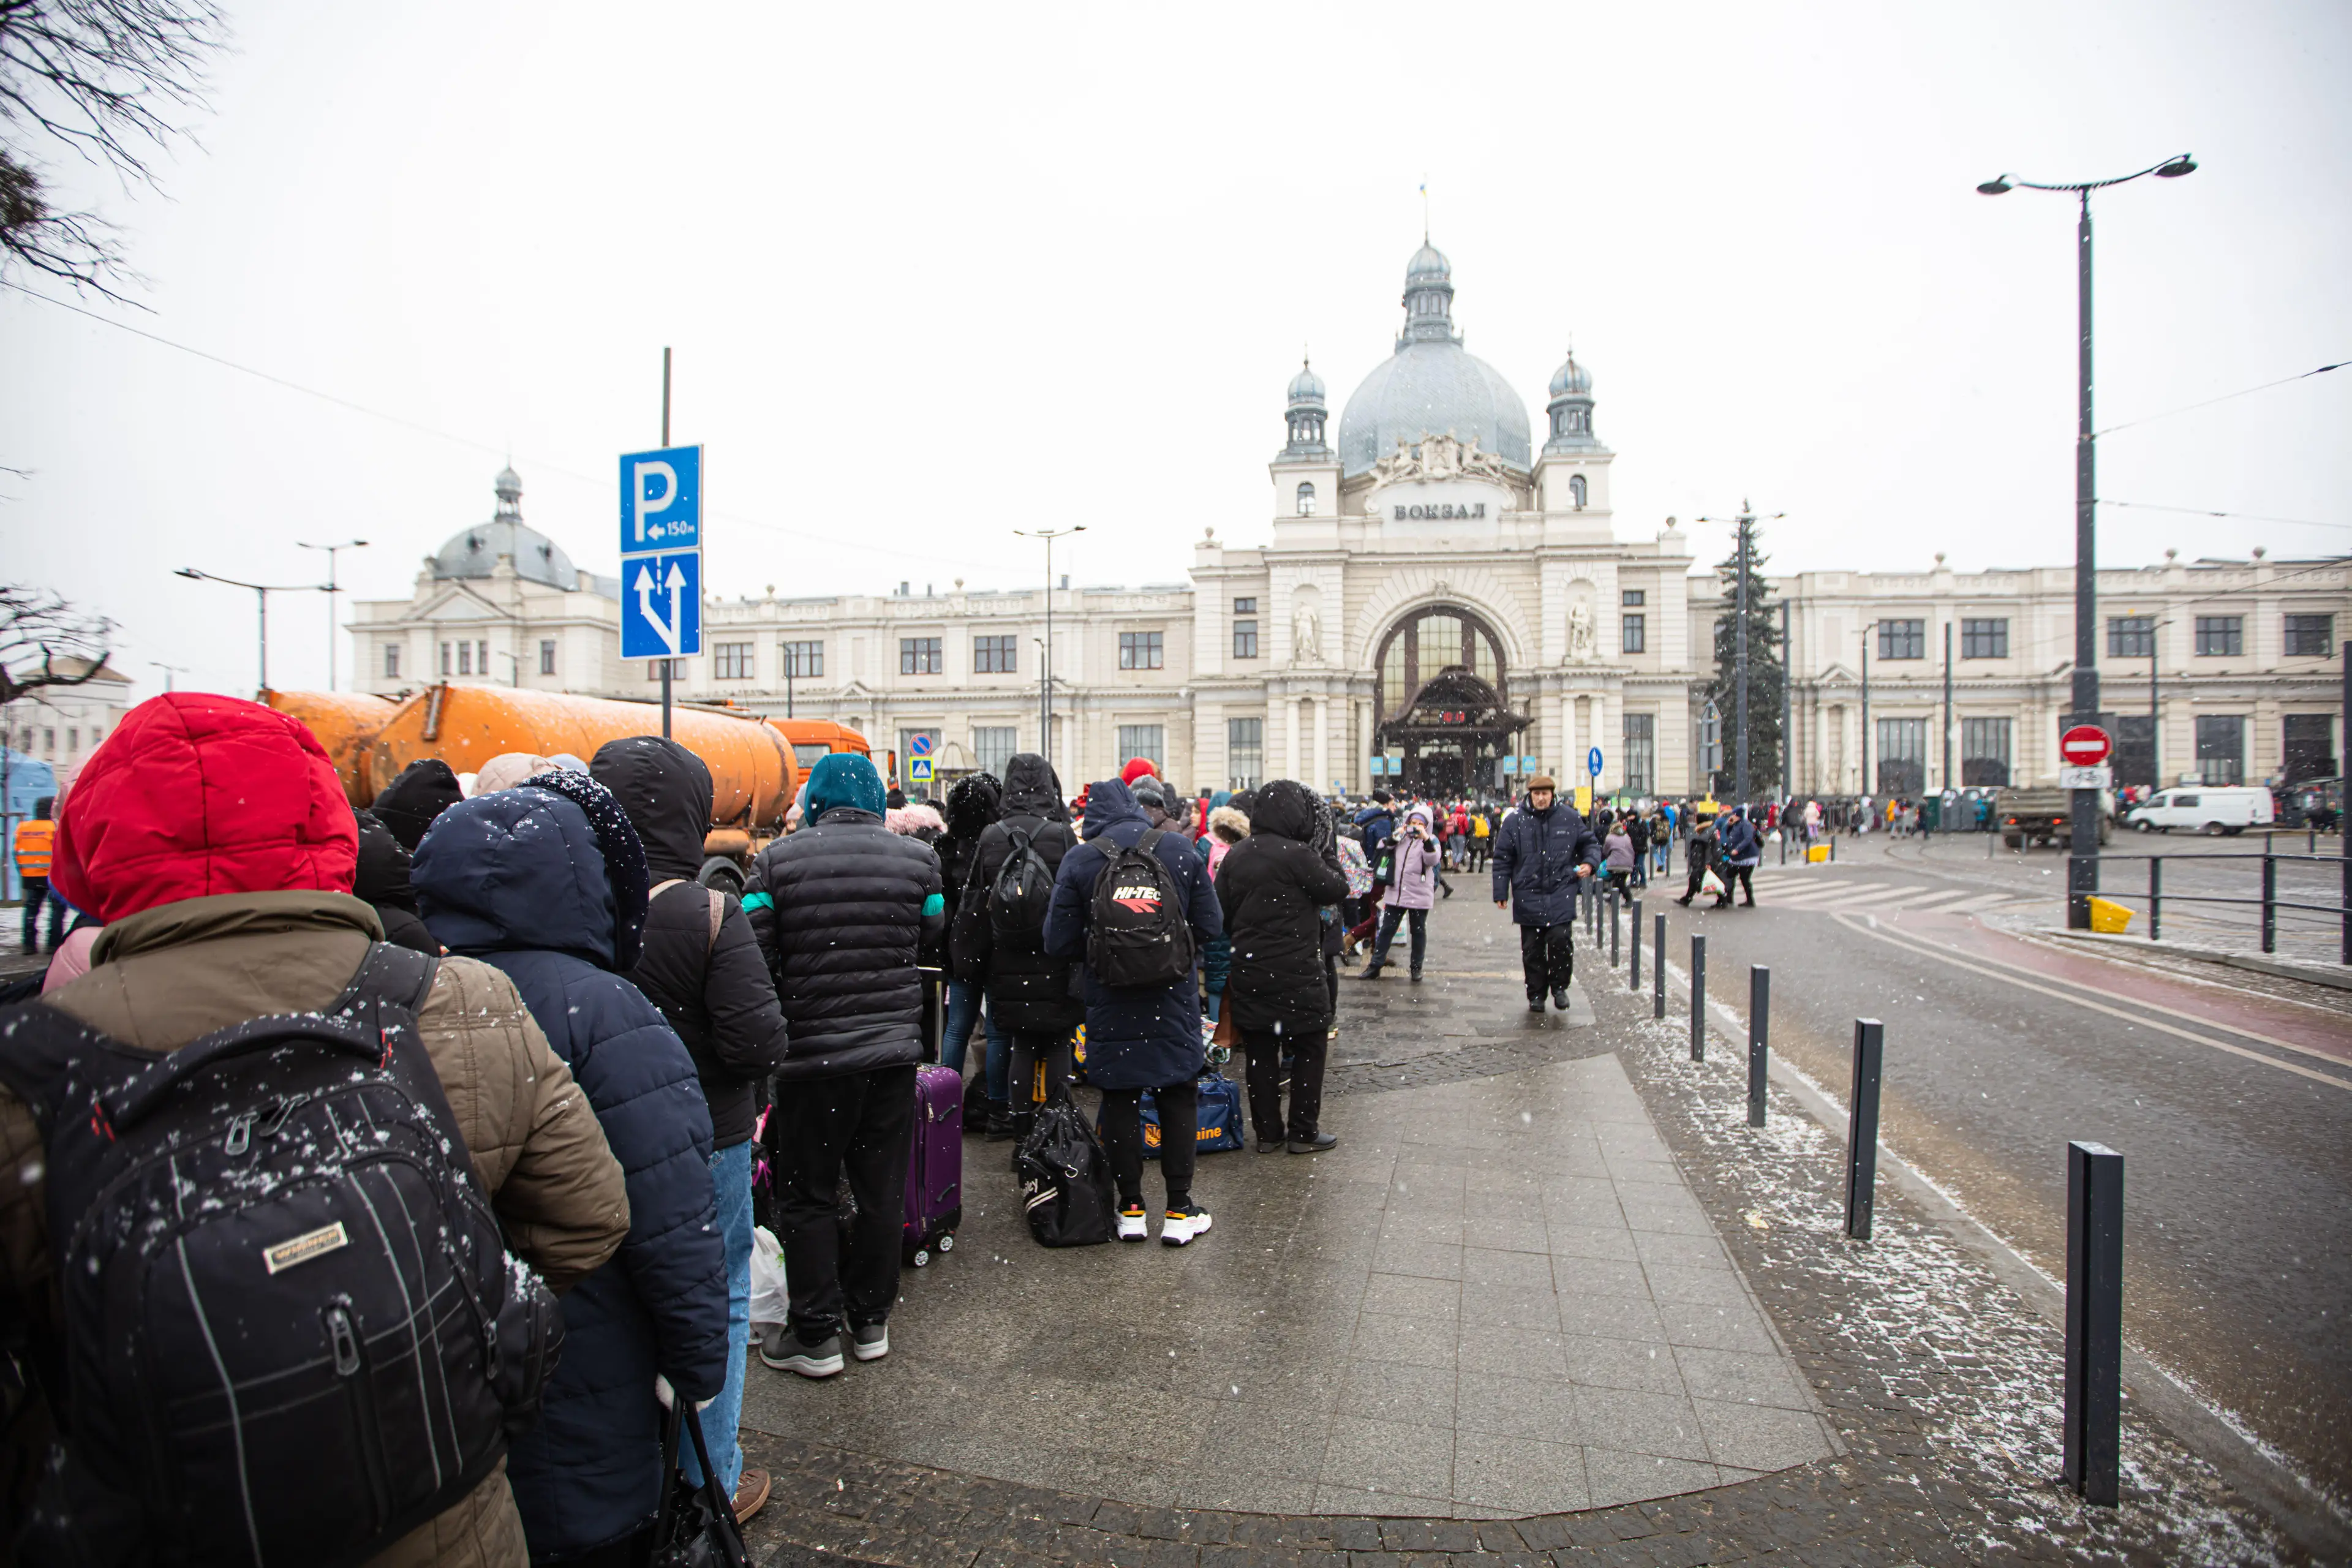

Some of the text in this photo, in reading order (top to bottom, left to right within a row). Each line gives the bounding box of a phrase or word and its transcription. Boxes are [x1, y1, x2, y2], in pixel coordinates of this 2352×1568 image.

[634, 461, 677, 543] P
[1394, 502, 1486, 520] ВОКЗАЛ
[1112, 886, 1161, 900] HI-TEC
